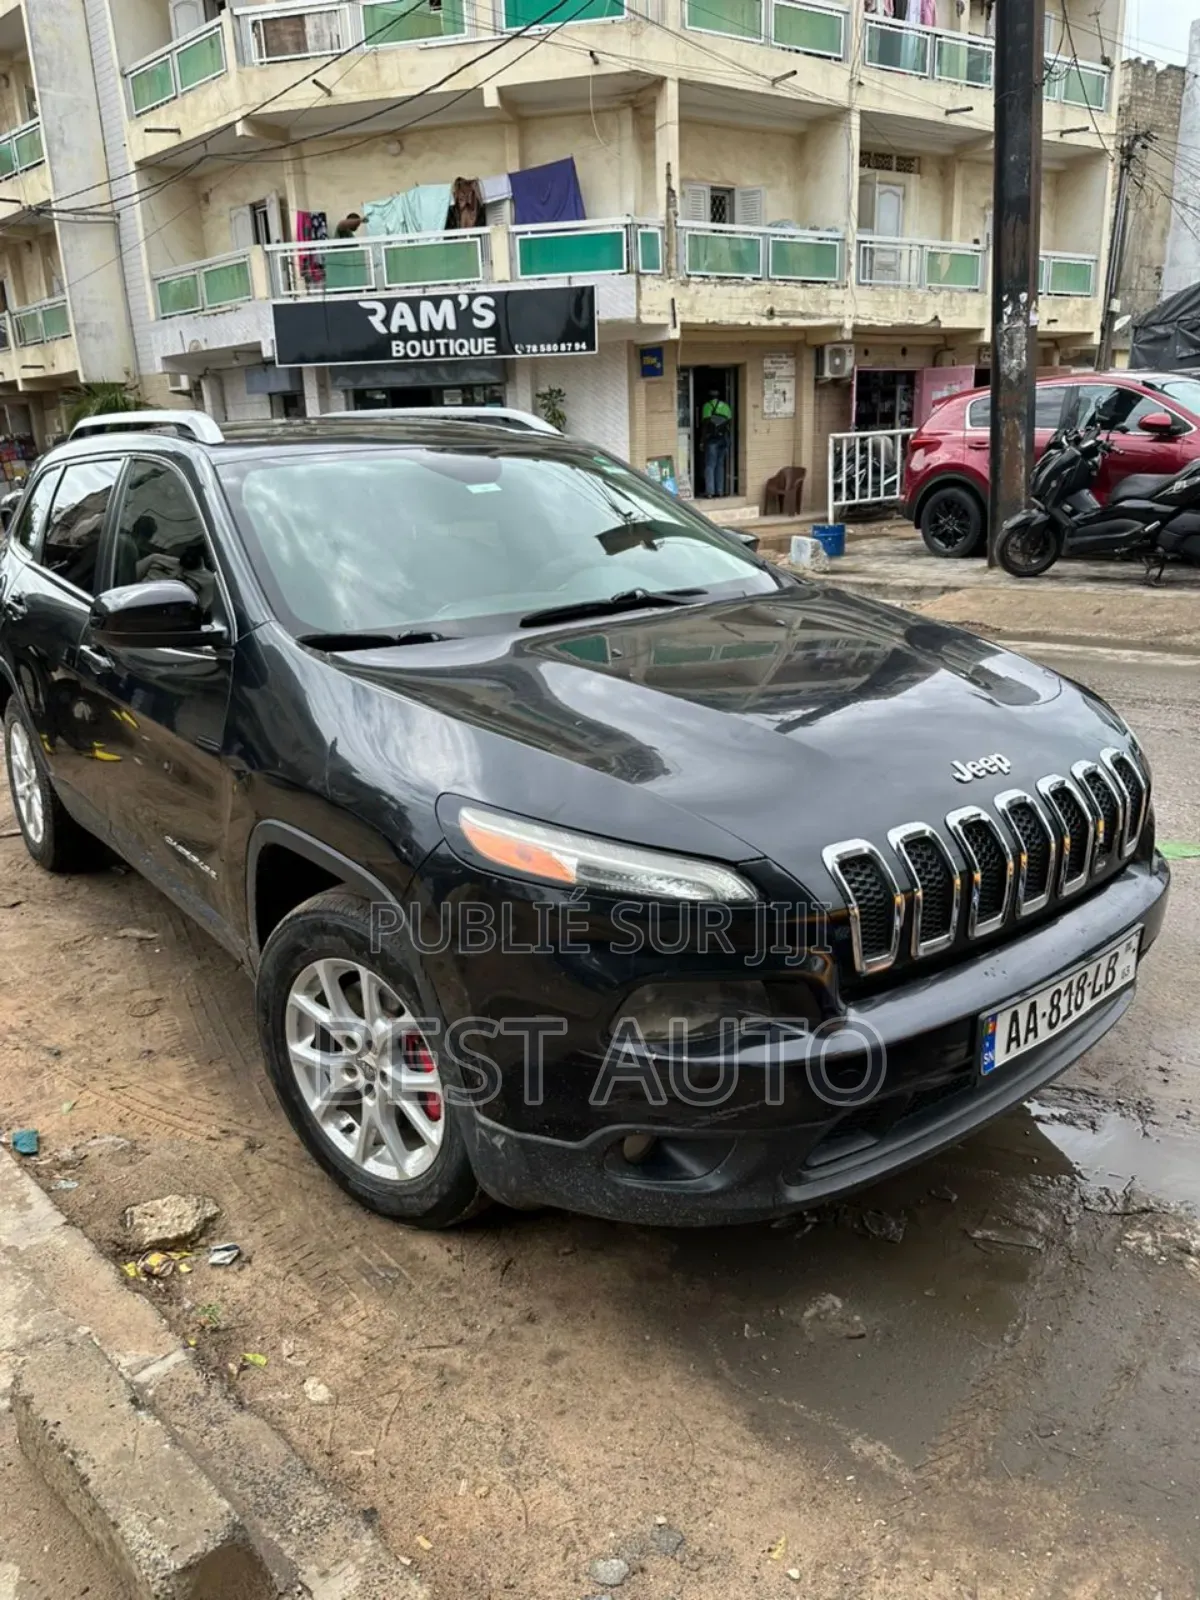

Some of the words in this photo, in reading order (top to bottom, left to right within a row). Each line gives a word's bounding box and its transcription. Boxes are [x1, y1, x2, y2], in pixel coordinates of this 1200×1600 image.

[358, 294, 496, 335] RAM'S
[391, 337, 497, 358] BOUTIQUE
[950, 753, 1011, 784] Jeep
